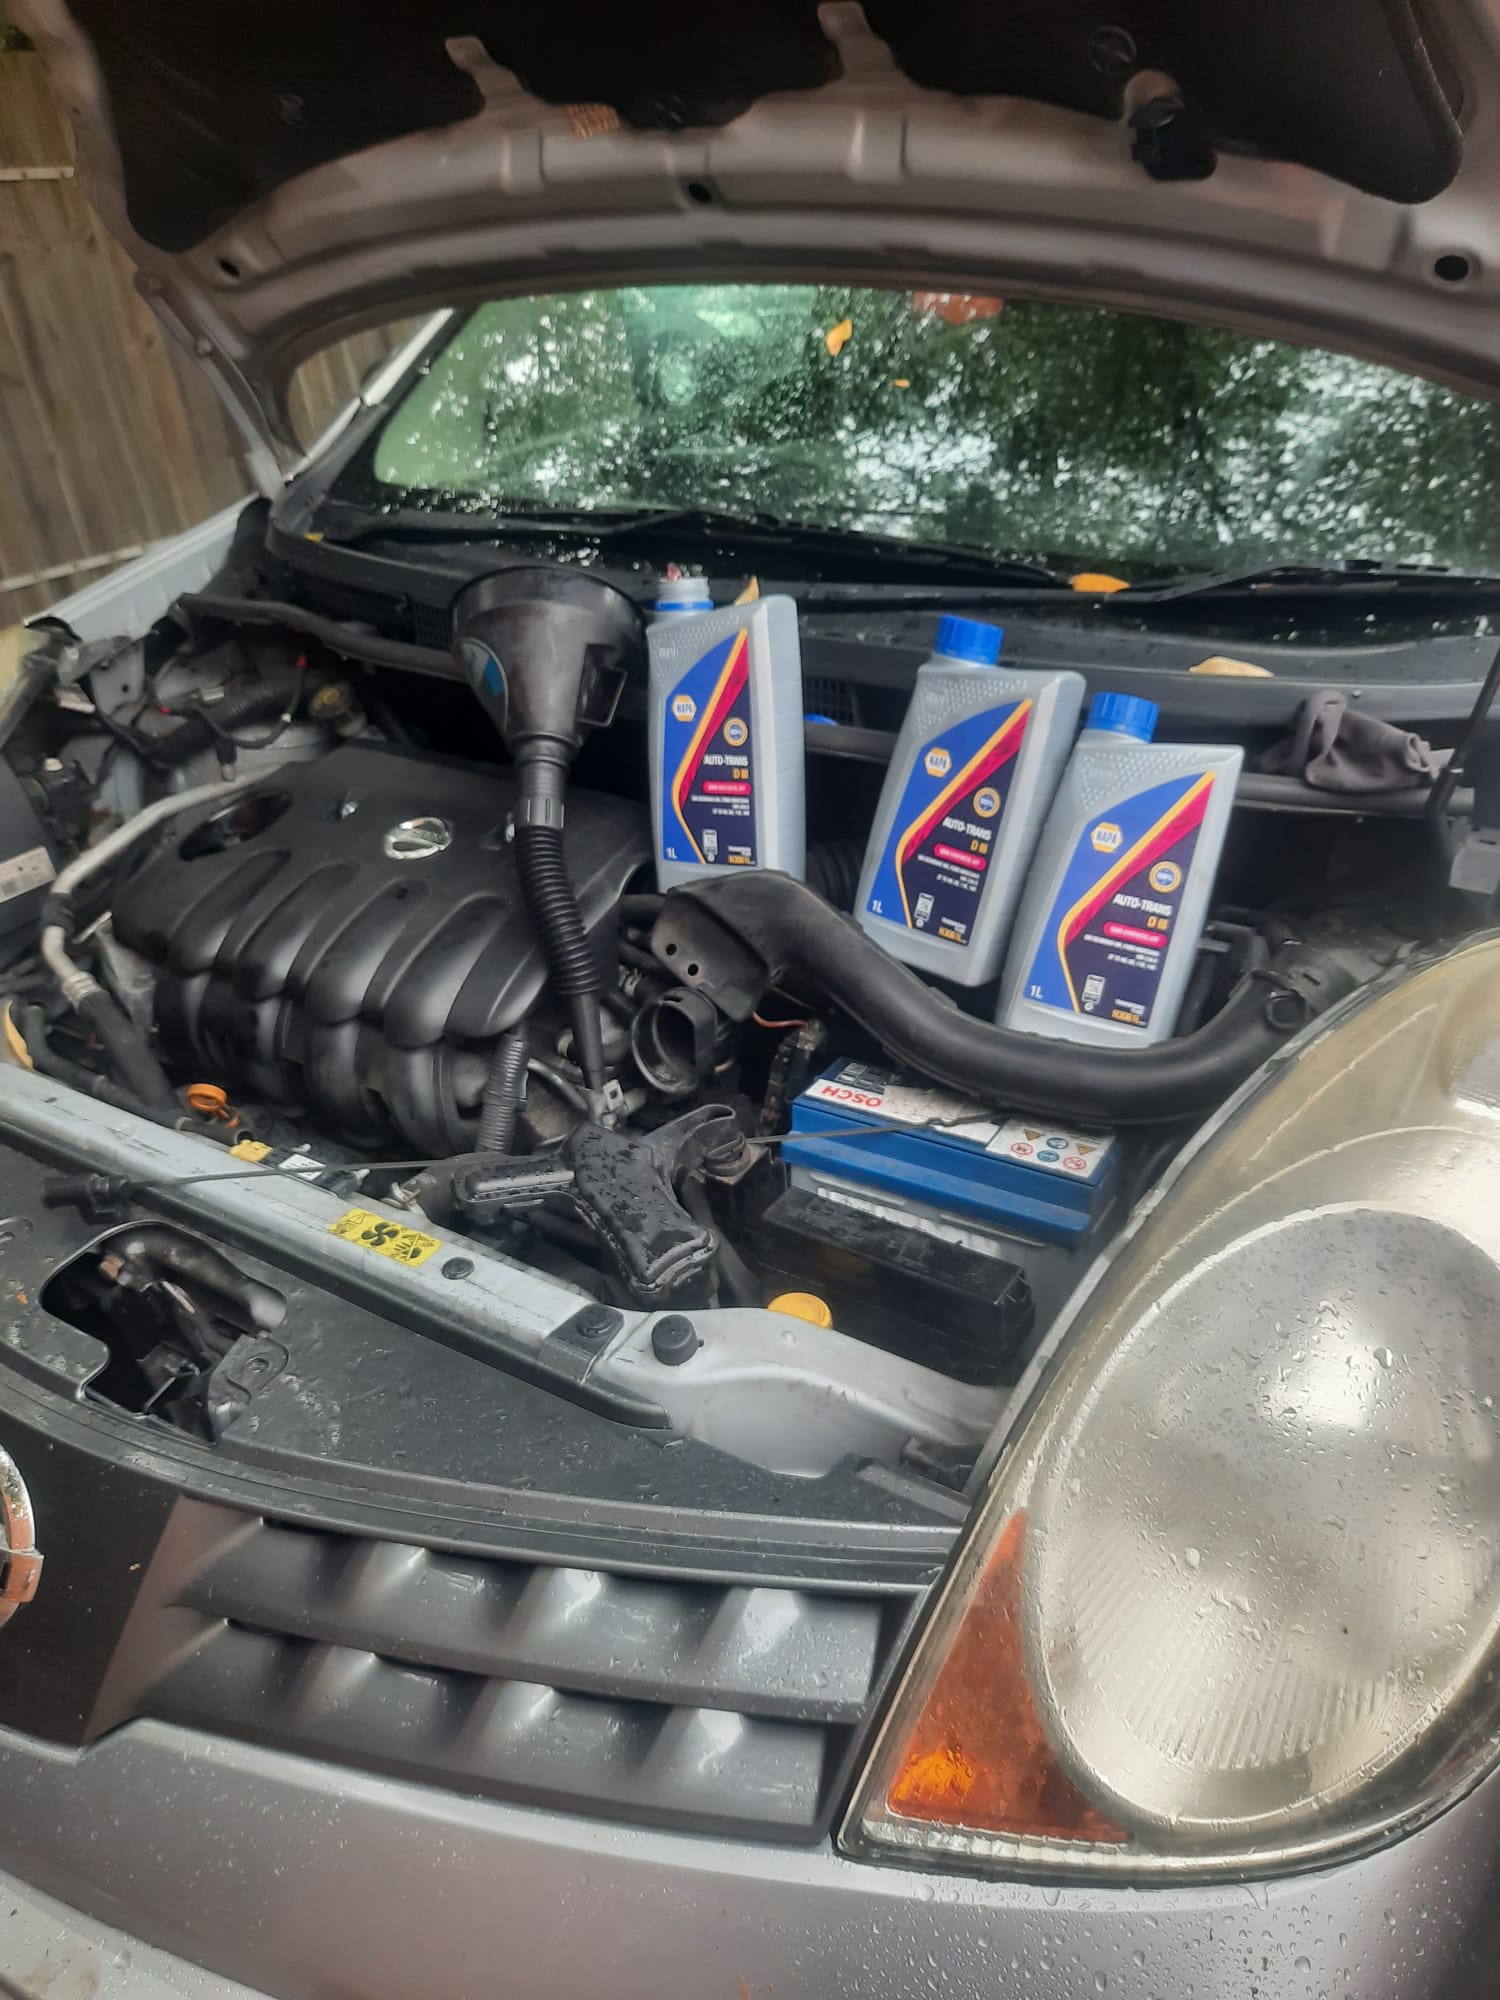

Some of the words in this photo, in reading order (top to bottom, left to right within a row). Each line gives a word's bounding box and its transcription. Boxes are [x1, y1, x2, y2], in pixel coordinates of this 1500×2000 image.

[676, 703, 694, 714] NAPA
[703, 754, 749, 767] AUTO-TRANS
[942, 816, 993, 841] AUTO-TRANS
[1095, 830, 1118, 846] NAPA
[665, 847, 678, 859] 1L
[872, 899, 883, 914] 1L
[1112, 893, 1172, 917] AUTO-TRANS
[1030, 984, 1043, 999] 1L
[821, 1085, 883, 1107] OSCH
